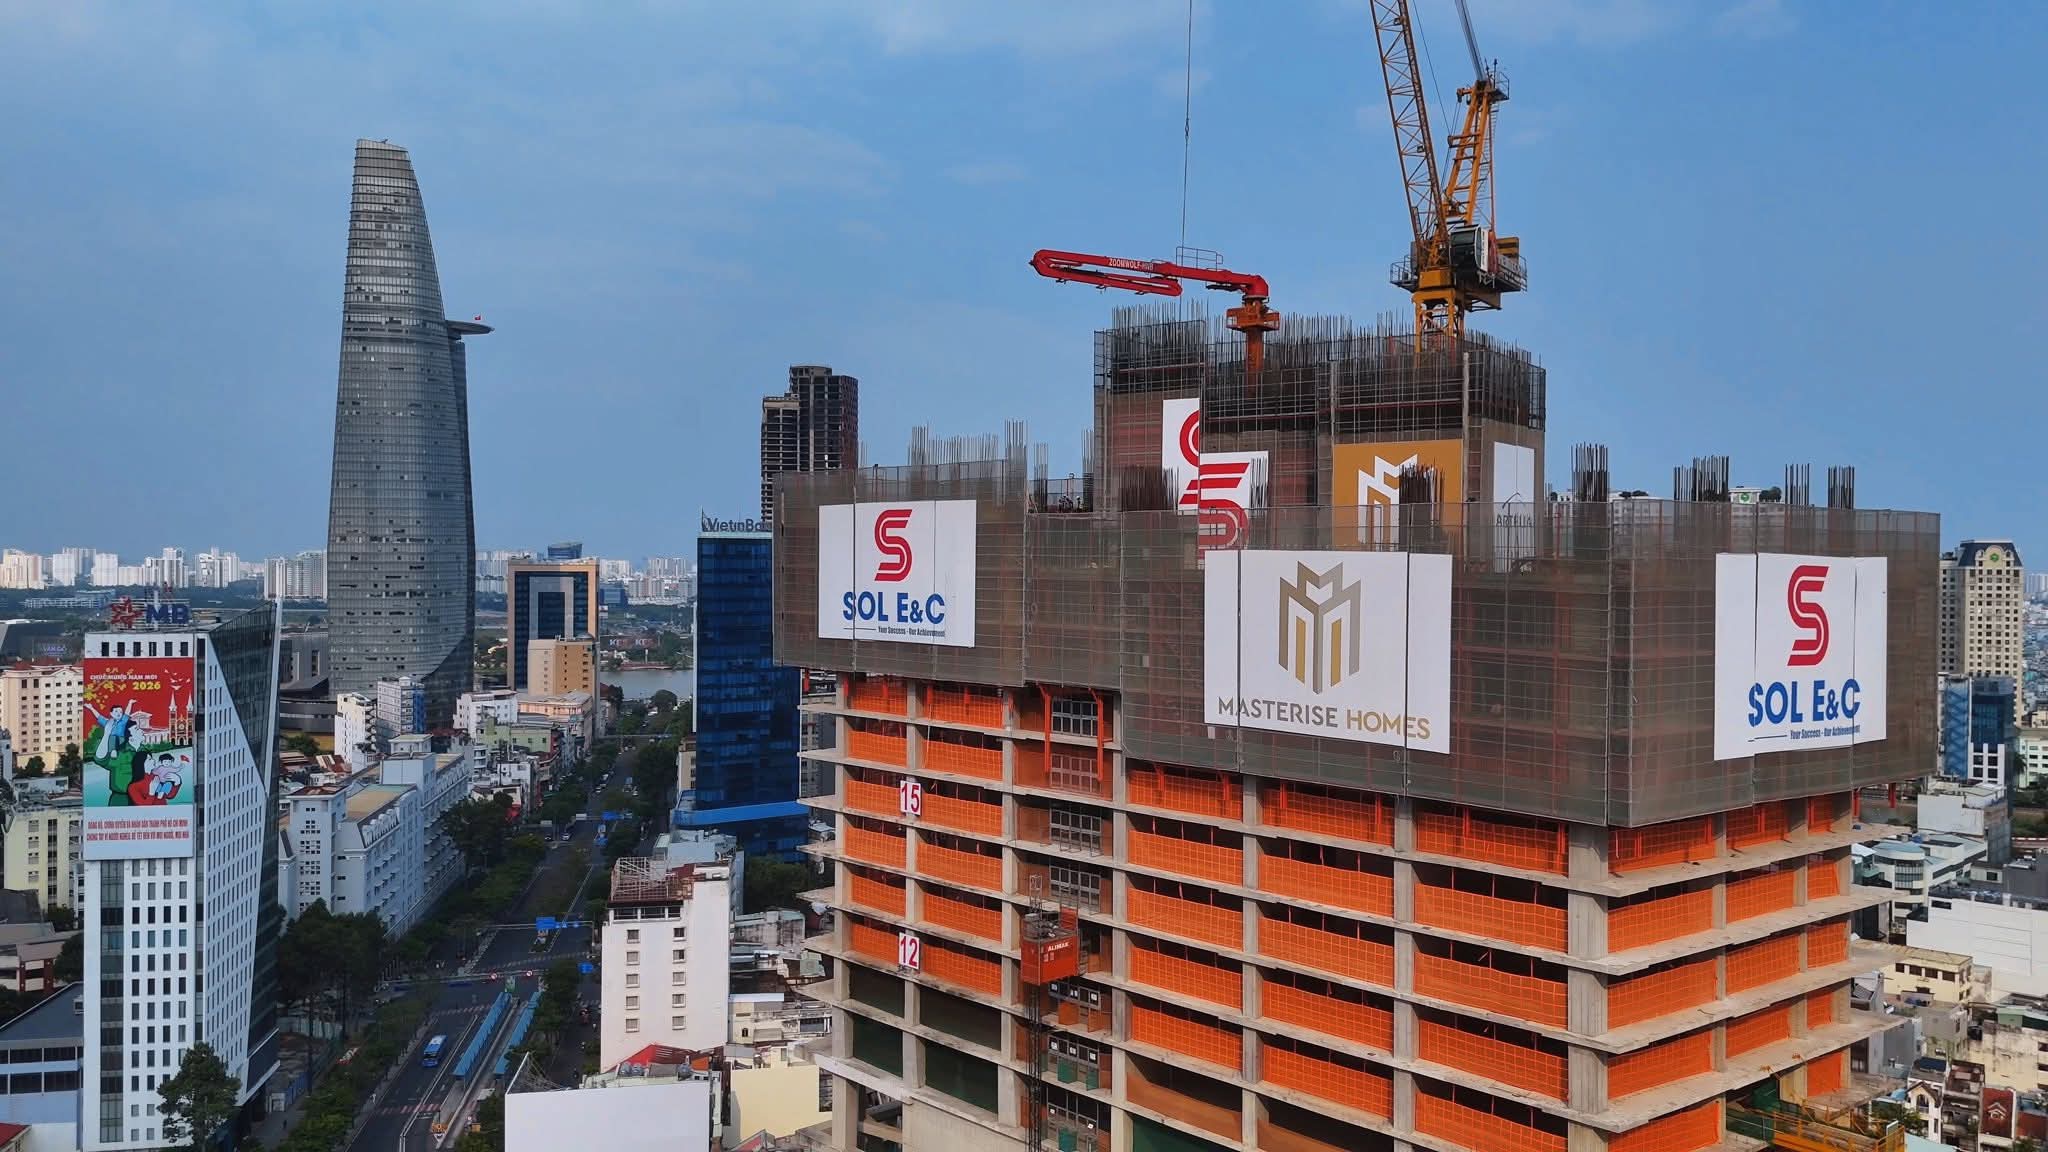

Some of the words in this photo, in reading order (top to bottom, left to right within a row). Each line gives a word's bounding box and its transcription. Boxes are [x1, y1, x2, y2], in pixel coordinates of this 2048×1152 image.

[146, 604, 188, 624] MB
[843, 591, 888, 622] SOL
[896, 592, 945, 624] E&C
[132, 681, 161, 690] 2026
[1218, 696, 1338, 728] MASTERISE
[1346, 708, 1431, 740] HOMES
[1748, 681, 1803, 727] SOL
[1812, 678, 1861, 722] E&C
[1801, 729, 1821, 739] Success
[901, 783, 920, 813] 15
[900, 935, 918, 968] 12
